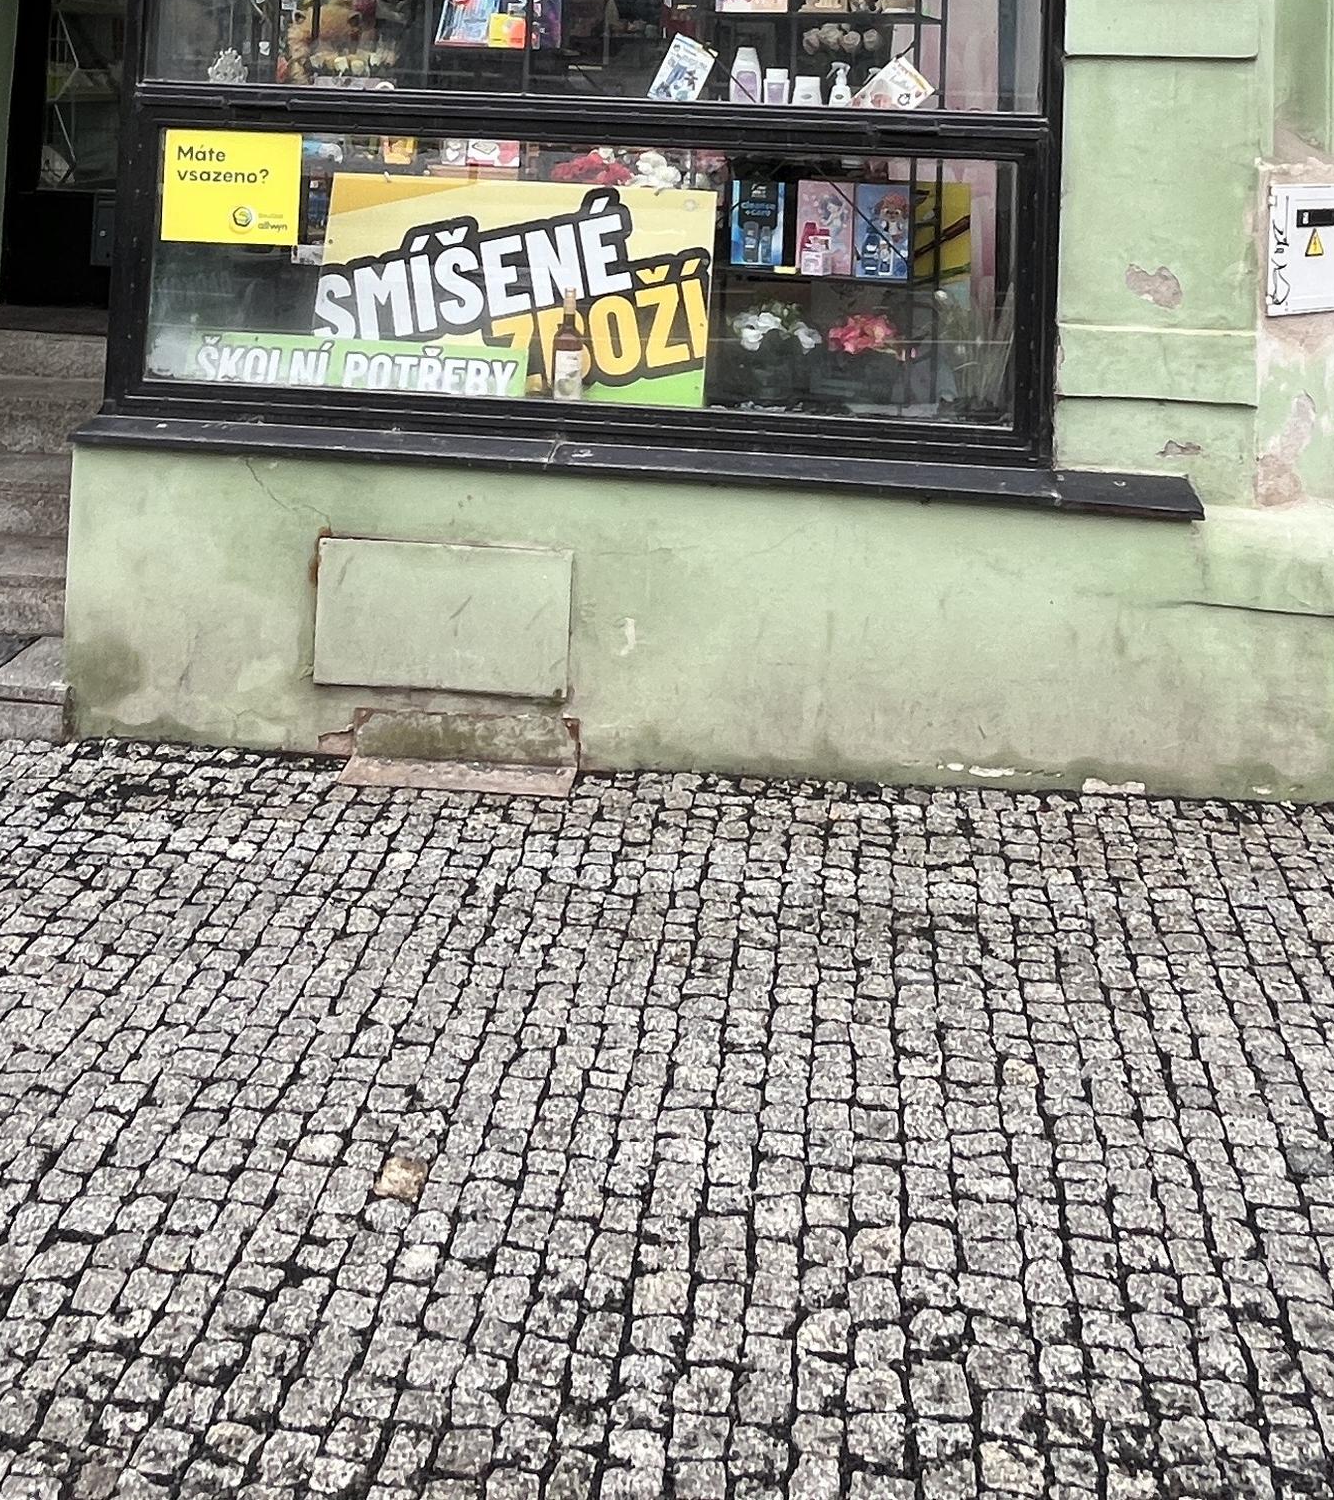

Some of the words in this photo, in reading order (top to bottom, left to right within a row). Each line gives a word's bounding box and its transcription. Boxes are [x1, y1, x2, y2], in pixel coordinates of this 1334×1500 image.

[177, 144, 226, 162] Máte
[177, 168, 269, 184] vsazeno?
[313, 196, 633, 341] SMÍŠENÉ
[196, 336, 335, 388] ŠKOLNÍ
[343, 346, 518, 397] POTŘEBY
